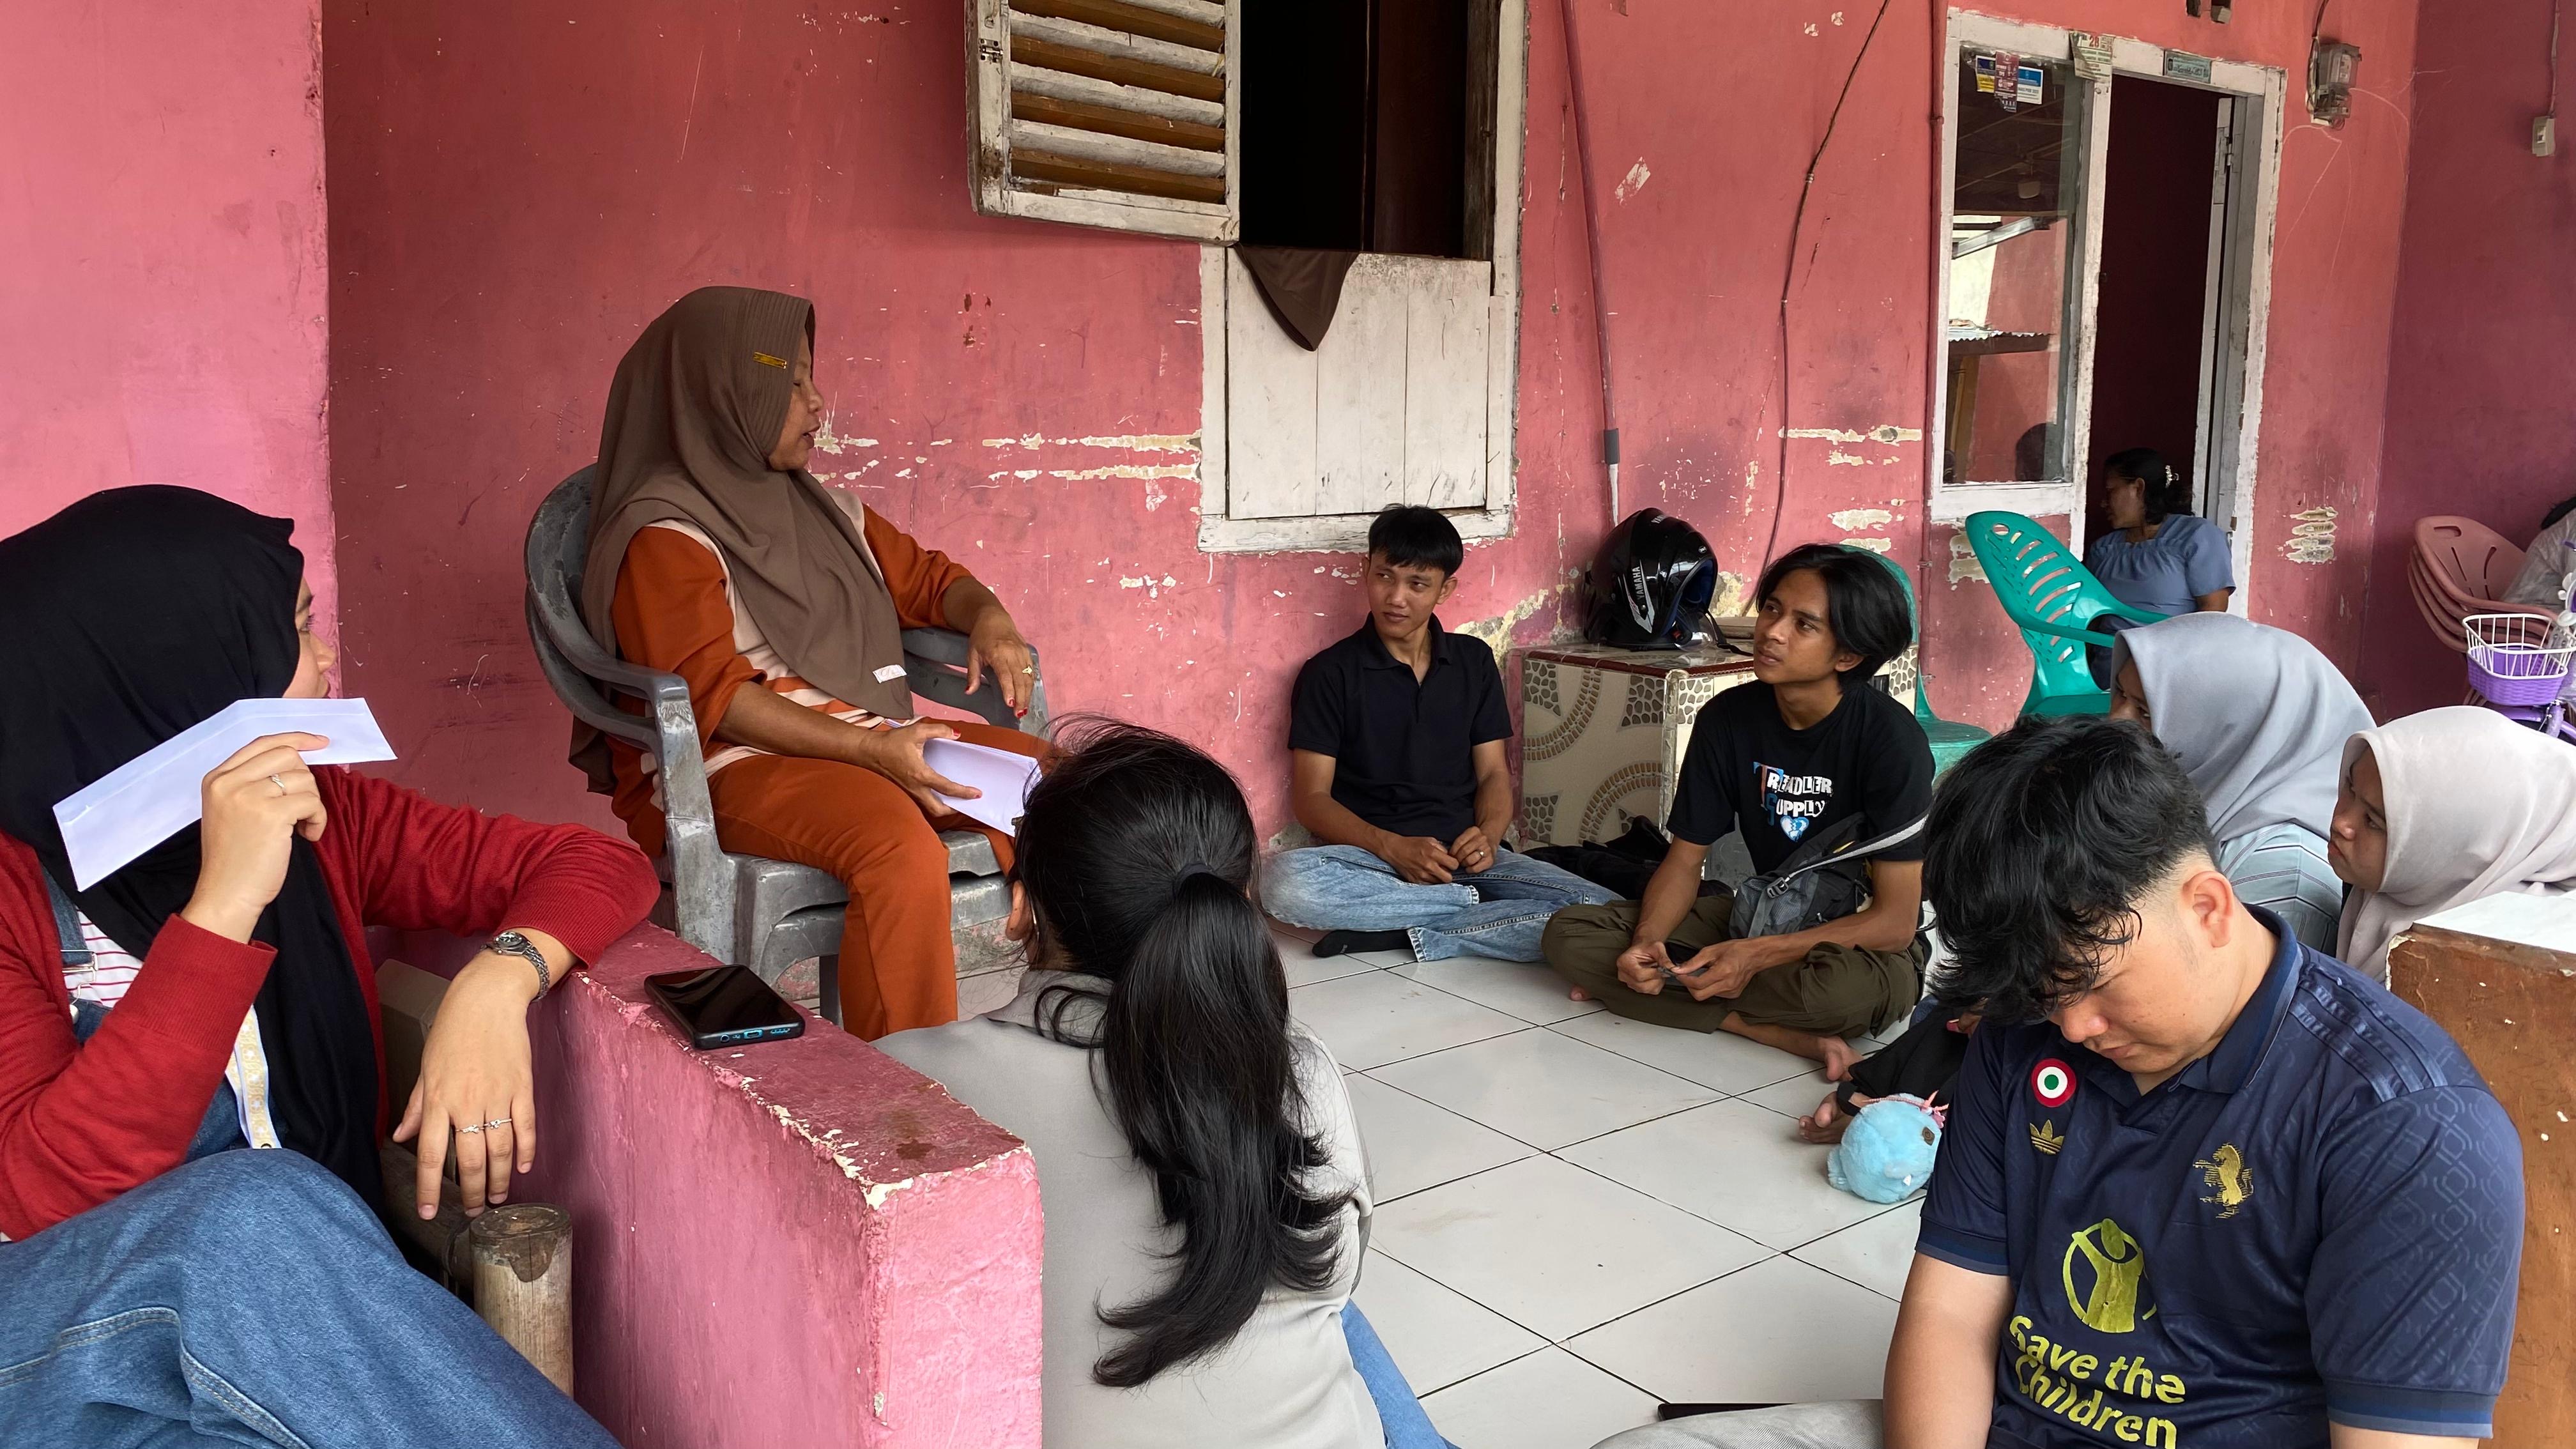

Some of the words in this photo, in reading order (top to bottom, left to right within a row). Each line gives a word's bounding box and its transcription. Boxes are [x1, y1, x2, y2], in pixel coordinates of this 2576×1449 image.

[1632, 566, 1645, 600] YAMAHA
[1766, 793, 1825, 826] SUPPLY
[2010, 1315, 2098, 1379] Save
[2105, 1356, 2186, 1404] the
[2015, 1354, 2177, 1449] Children
